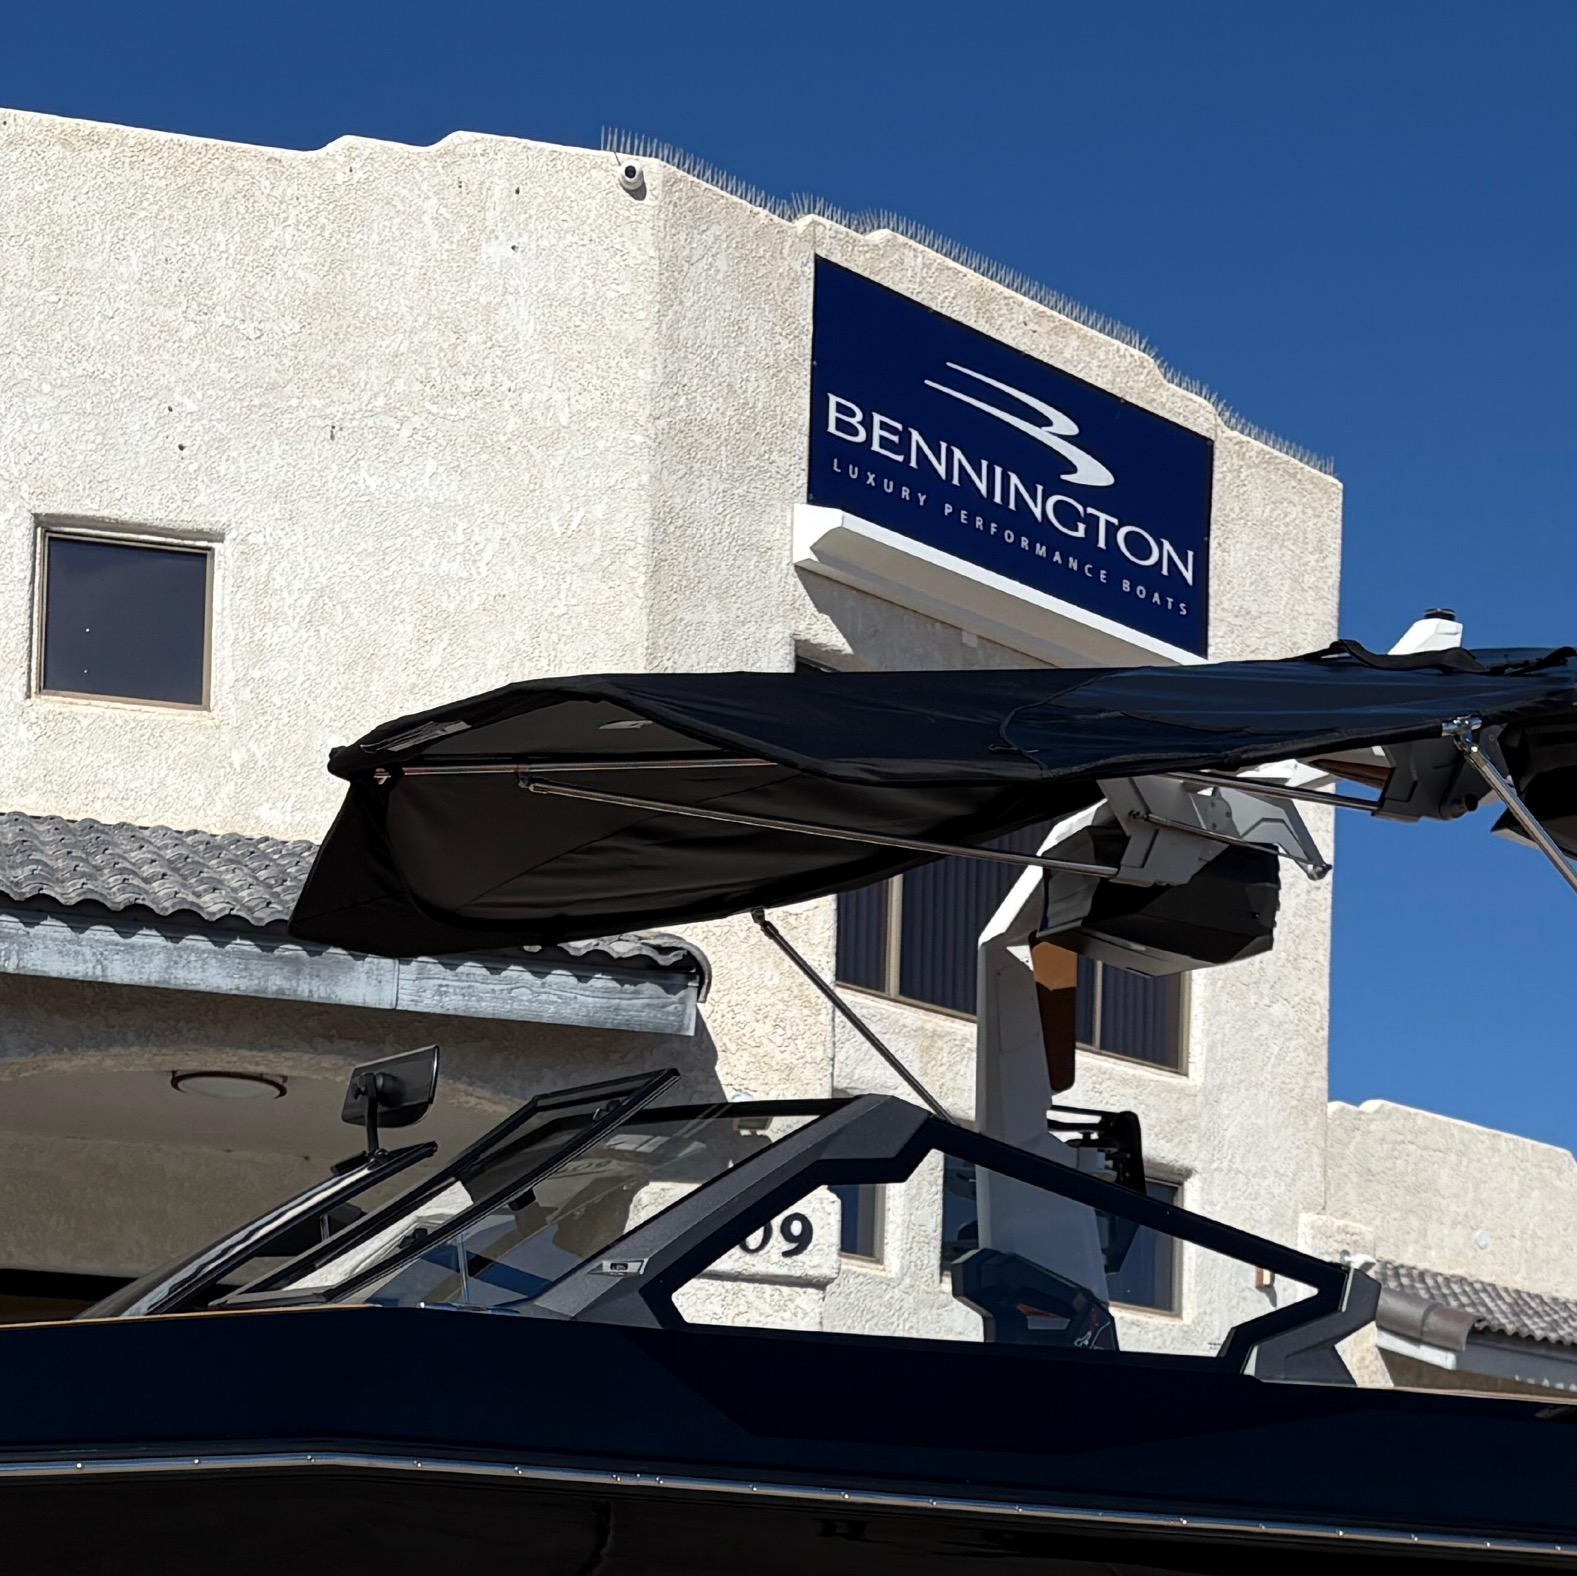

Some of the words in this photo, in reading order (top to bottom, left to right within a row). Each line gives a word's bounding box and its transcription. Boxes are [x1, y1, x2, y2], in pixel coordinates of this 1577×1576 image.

[826, 392, 1194, 586] BENNINGTON
[832, 458, 927, 506] LUXURY
[944, 503, 1107, 583] PERFORMANCE
[1122, 579, 1187, 615] BOATS
